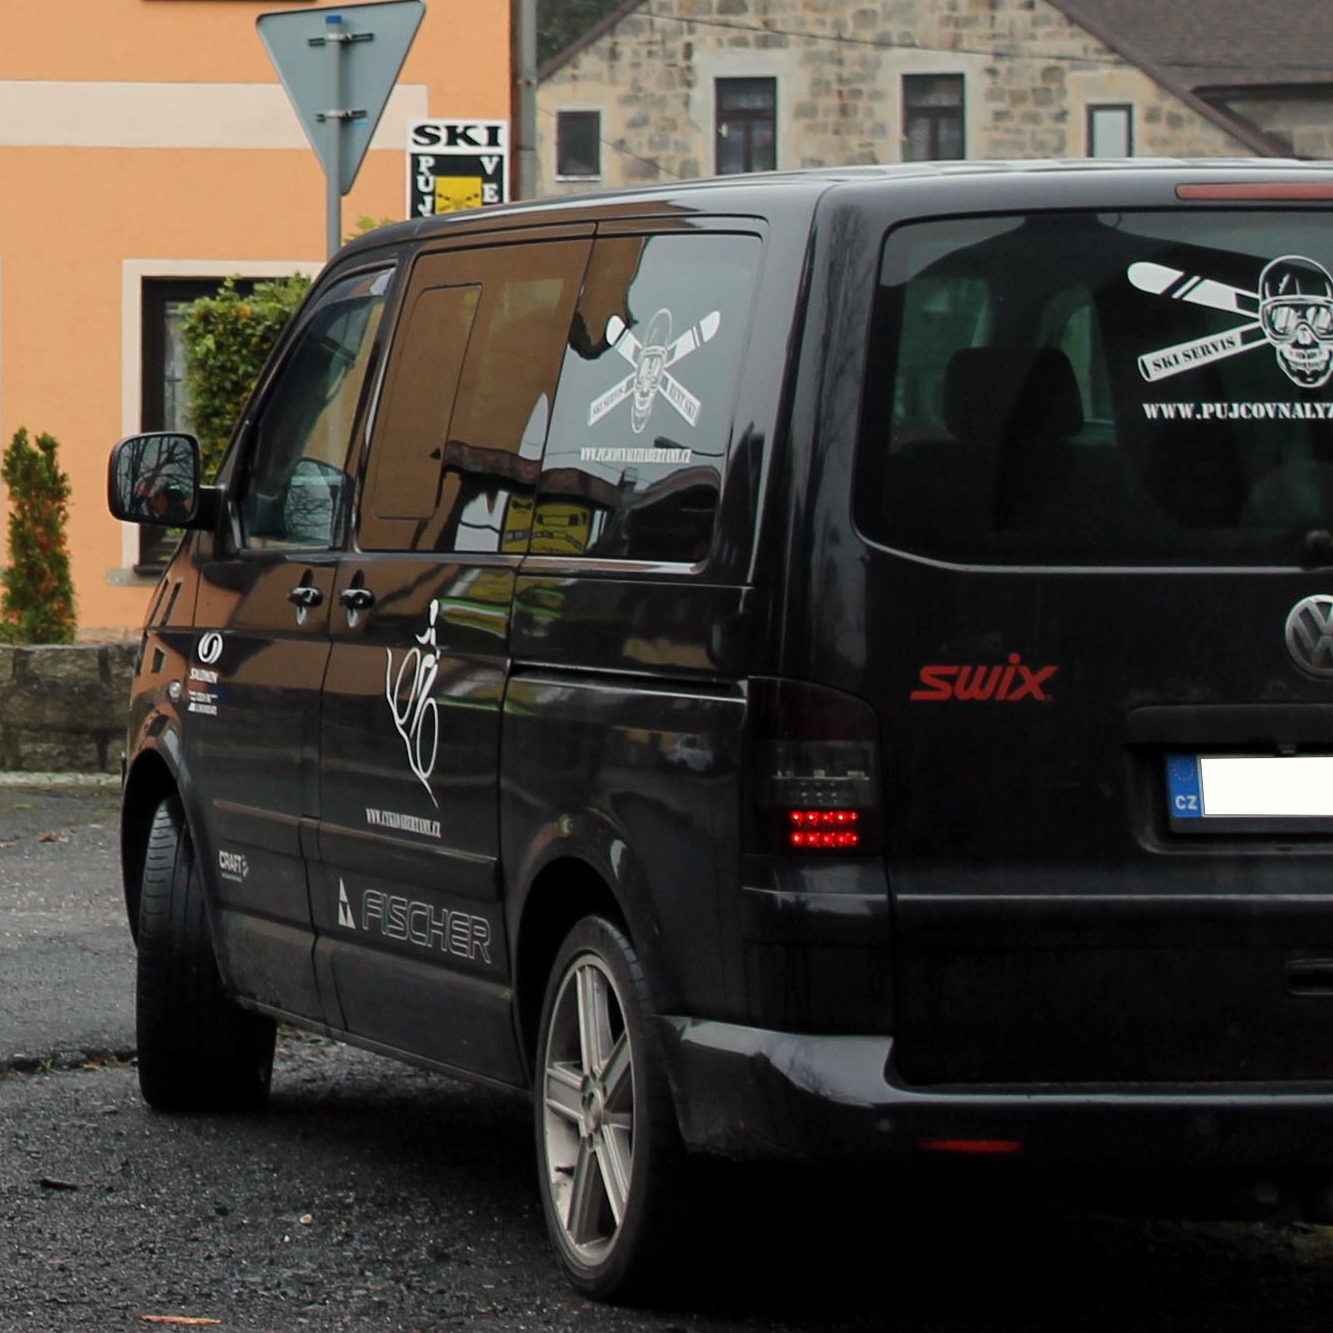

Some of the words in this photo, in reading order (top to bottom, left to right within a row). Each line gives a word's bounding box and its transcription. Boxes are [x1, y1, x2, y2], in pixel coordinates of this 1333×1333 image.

[412, 124, 502, 147] SKI
[1152, 354, 1180, 372] SKI
[1182, 336, 1236, 363] SERVIS
[1175, 795, 1198, 809] CZ
[362, 889, 492, 964] FISCHER
